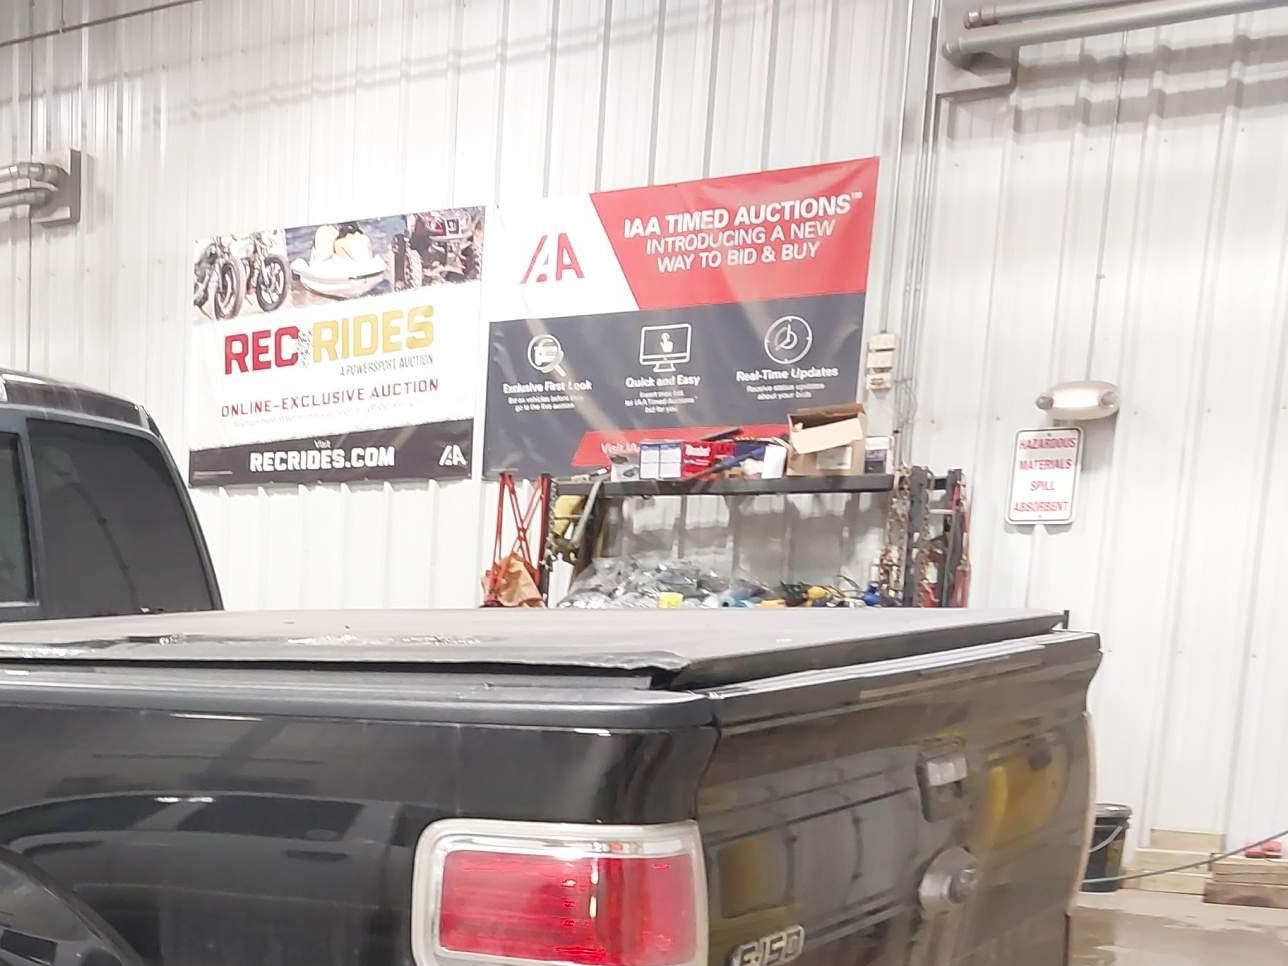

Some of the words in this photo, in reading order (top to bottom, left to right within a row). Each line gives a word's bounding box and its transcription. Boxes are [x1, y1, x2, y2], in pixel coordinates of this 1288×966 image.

[624, 216, 661, 238] IAA
[665, 208, 729, 234] TIMED
[646, 226, 766, 255] INTRODUCING
[770, 225, 785, 242] A
[790, 219, 836, 240] NEW
[657, 254, 695, 274] WAY
[699, 251, 722, 269] TO
[727, 248, 757, 267] BID
[761, 246, 776, 263] &
[781, 241, 820, 262] BUY
[224, 325, 301, 375] REC
[312, 304, 435, 364] RIDES
[399, 353, 434, 372] AUCTION
[625, 376, 656, 389] Quick
[656, 375, 676, 387] and
[677, 374, 701, 388] Easy
[736, 369, 789, 383] Real-Time
[790, 366, 839, 381] Updates
[502, 381, 544, 394] Exclusive
[544, 380, 566, 391] First
[567, 379, 593, 391] Look
[221, 388, 366, 418] ONLINE-EXCLUSIVE
[370, 377, 439, 399] AUCTION
[1019, 437, 1077, 450] HAZARDOUS
[249, 446, 395, 472] RECRIDES.COM
[1019, 458, 1073, 471] MATERIALS
[1030, 480, 1056, 492] SPILL
[1014, 500, 1069, 512] ABSORBENT
